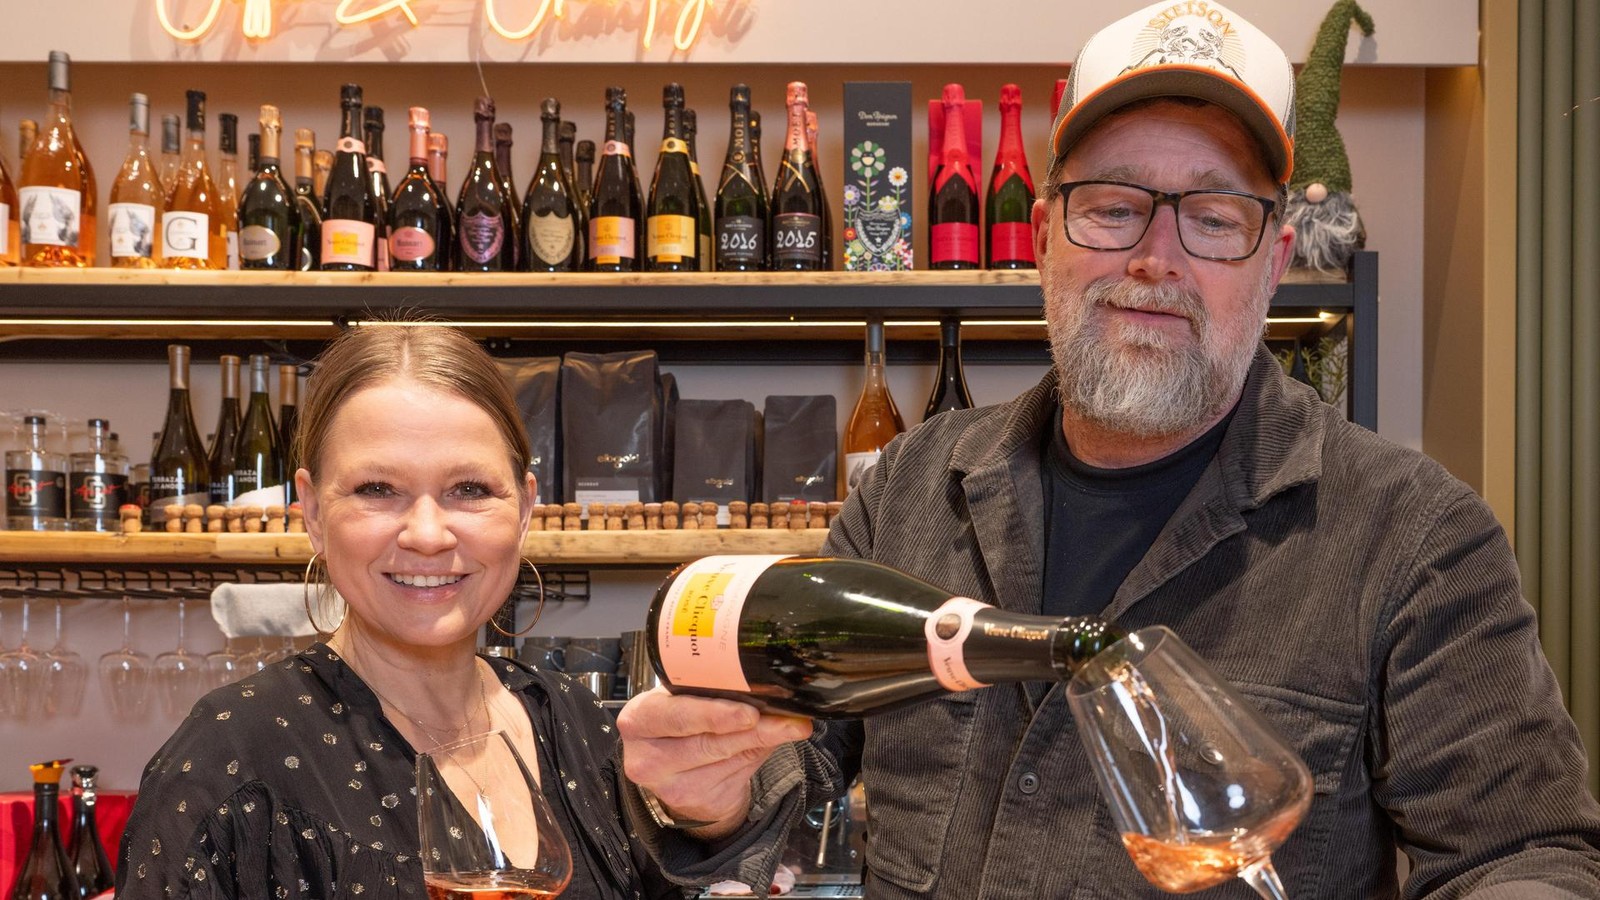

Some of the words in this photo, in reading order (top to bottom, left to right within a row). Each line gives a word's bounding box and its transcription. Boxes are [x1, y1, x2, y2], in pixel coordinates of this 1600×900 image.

[1149, 0, 1236, 36] STETSON
[165, 216, 198, 251] G
[721, 232, 758, 250] 2016
[776, 229, 817, 249] 2015
[703, 562, 737, 592] Veuve
[689, 595, 709, 657] Clicquot
[943, 656, 958, 682] Veuve
